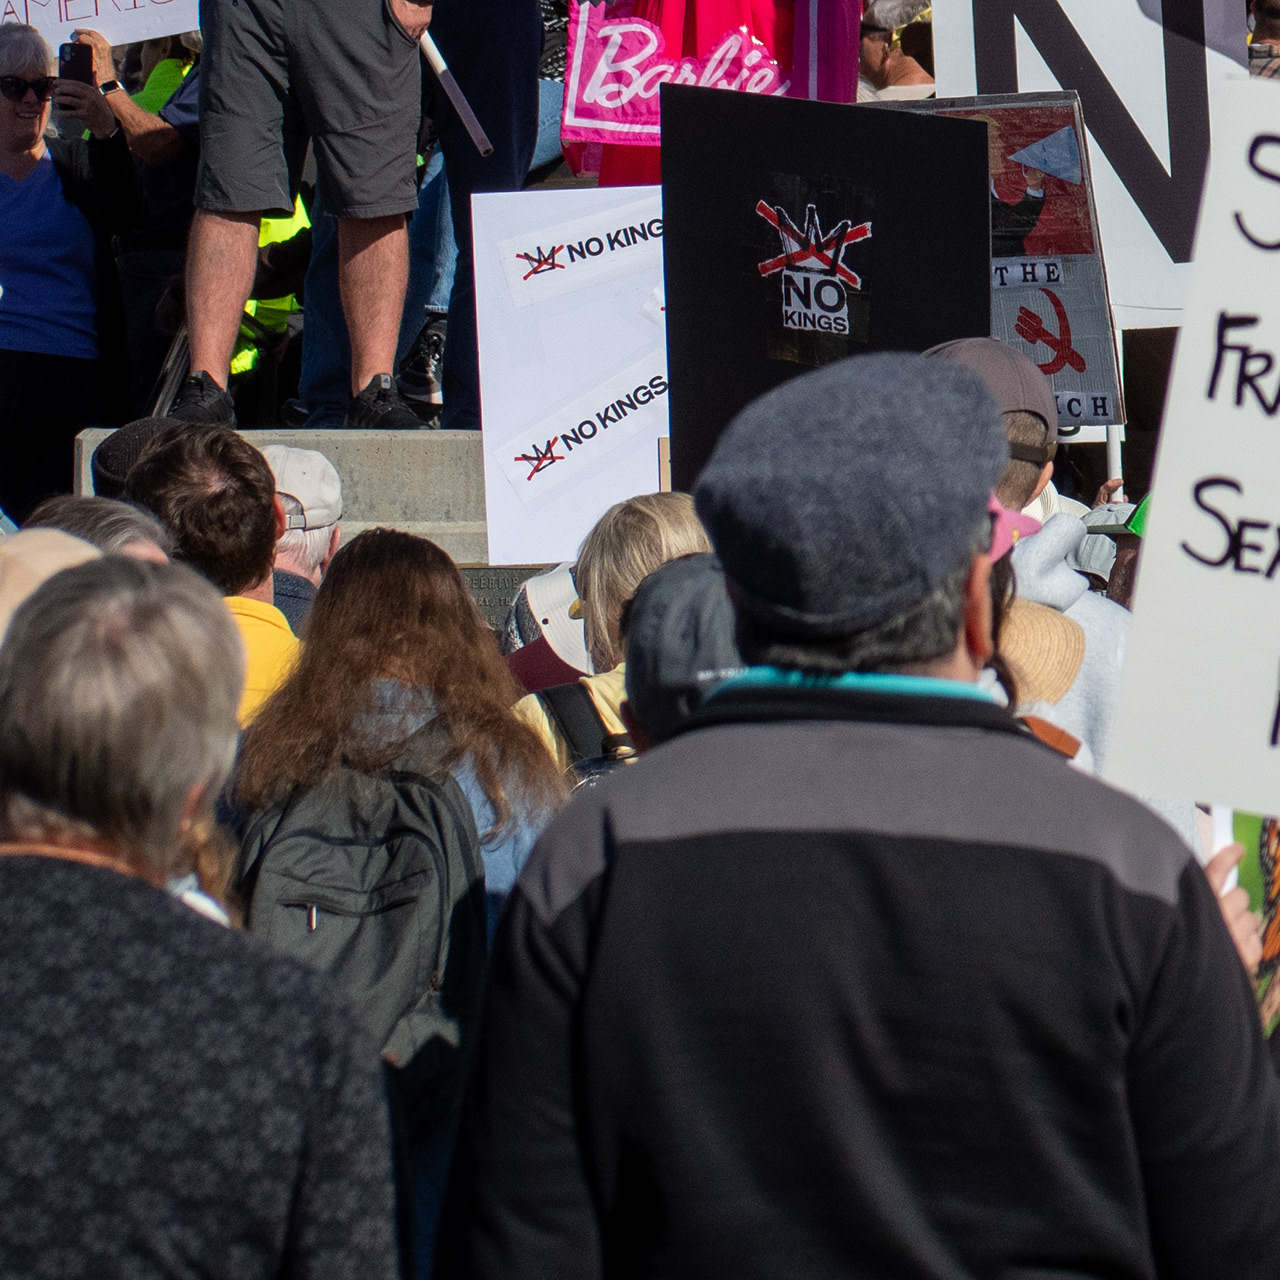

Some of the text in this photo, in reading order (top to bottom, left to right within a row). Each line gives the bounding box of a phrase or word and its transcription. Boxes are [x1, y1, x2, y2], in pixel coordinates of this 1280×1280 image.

[566, 234, 605, 263] NO
[994, 263, 1060, 286] THE
[784, 273, 847, 314] NO
[784, 311, 849, 334] KINGS
[560, 374, 668, 451] NO KINGS
[463, 577, 520, 590] BEEHIVE
